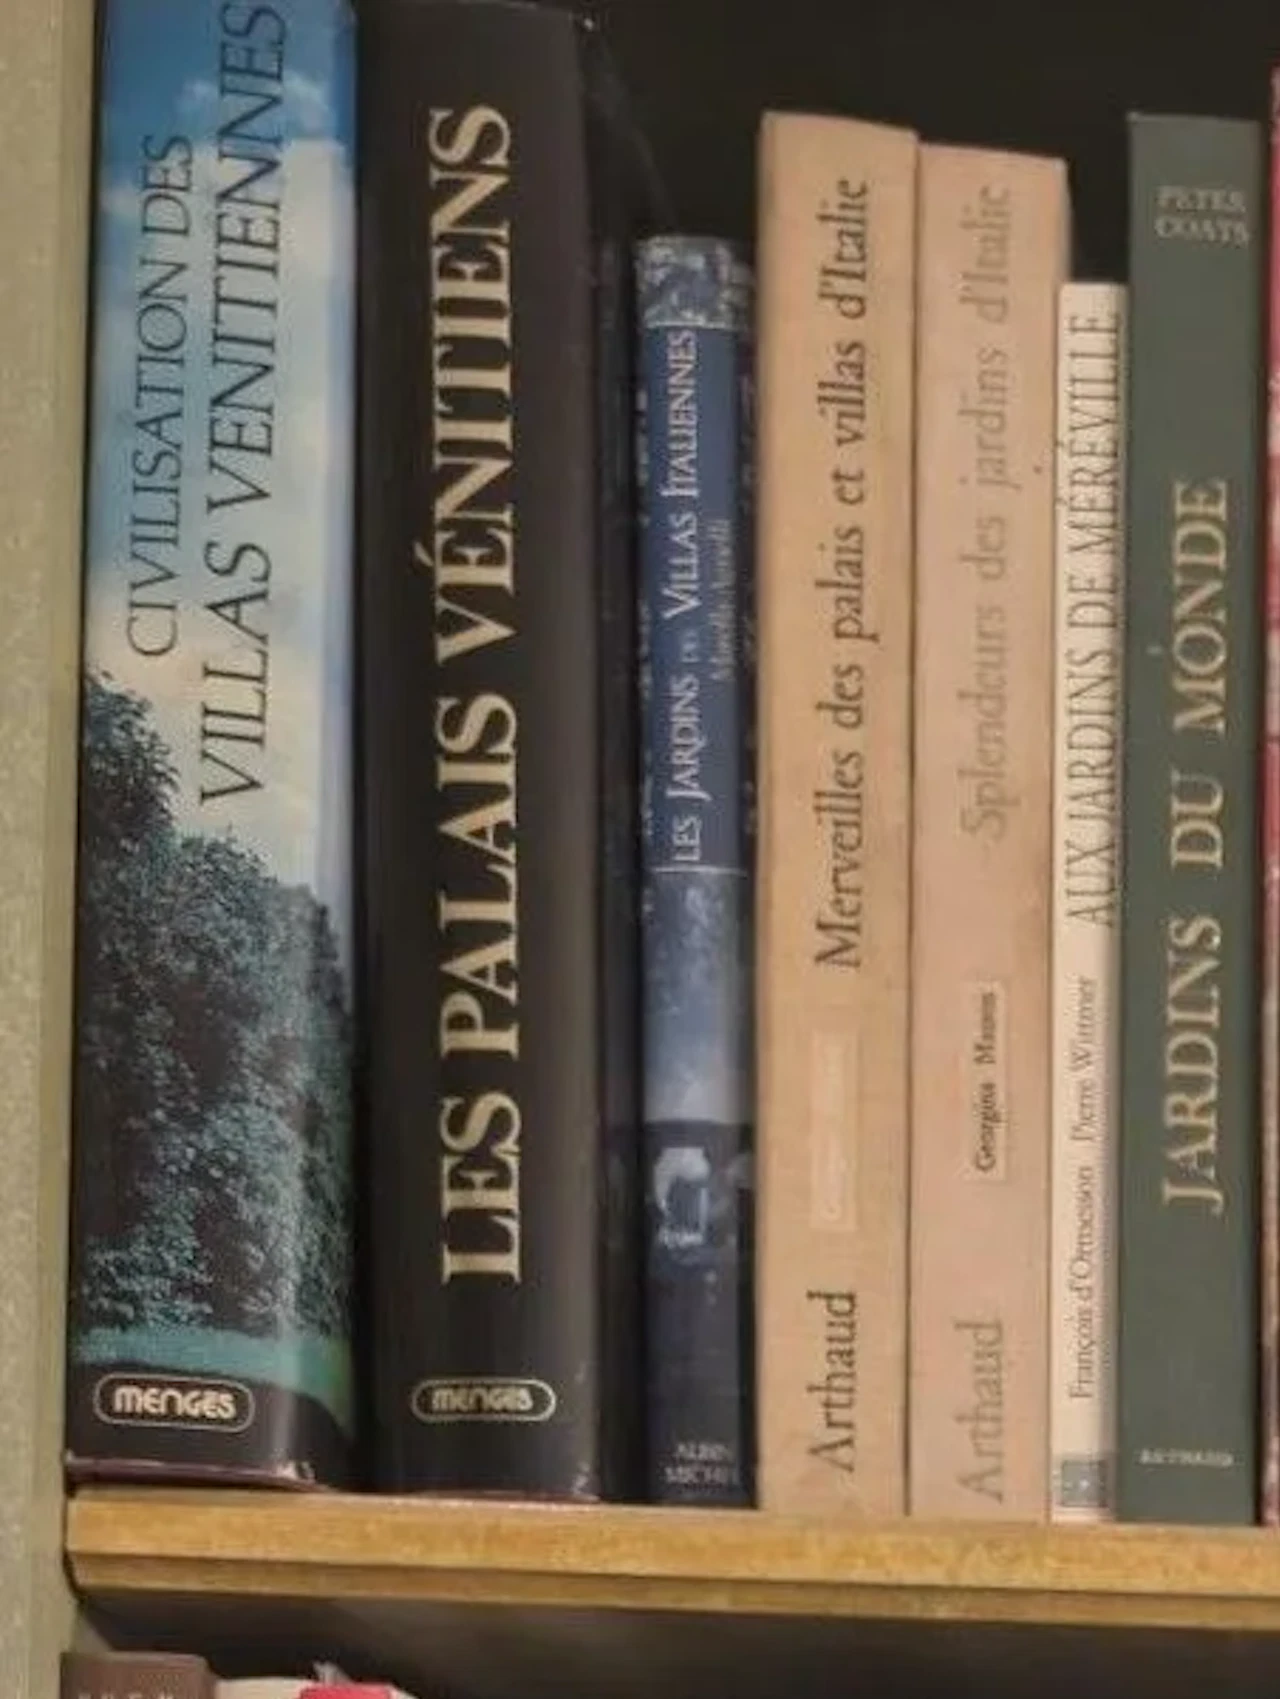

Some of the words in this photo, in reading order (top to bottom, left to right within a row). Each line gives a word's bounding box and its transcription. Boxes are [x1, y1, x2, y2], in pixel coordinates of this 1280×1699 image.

[139, 133, 194, 236] DES
[205, 2, 283, 513] VENITIENNES
[816, 179, 870, 321] d'Italie
[959, 185, 1010, 323] d'Italie
[125, 255, 192, 657] CIVILISATION
[413, 103, 516, 663] VÉNITIENS
[818, 340, 866, 449] villas
[960, 346, 1020, 491] jardins
[826, 467, 864, 506] et
[959, 513, 1008, 581] des
[200, 539, 269, 800] VILLAS
[818, 525, 879, 643] palais
[1171, 476, 1229, 736] MONDE
[816, 664, 863, 730] des
[957, 603, 1020, 842] Splendeurs
[433, 694, 519, 1060] PALAIS
[813, 750, 862, 969] Merveilles
[1169, 770, 1224, 868] DU
[1163, 914, 1224, 1213] JARDINS
[440, 1091, 522, 1283] LES
[807, 1288, 858, 1474] Arthaud
[955, 1318, 1004, 1504] Arthaud
